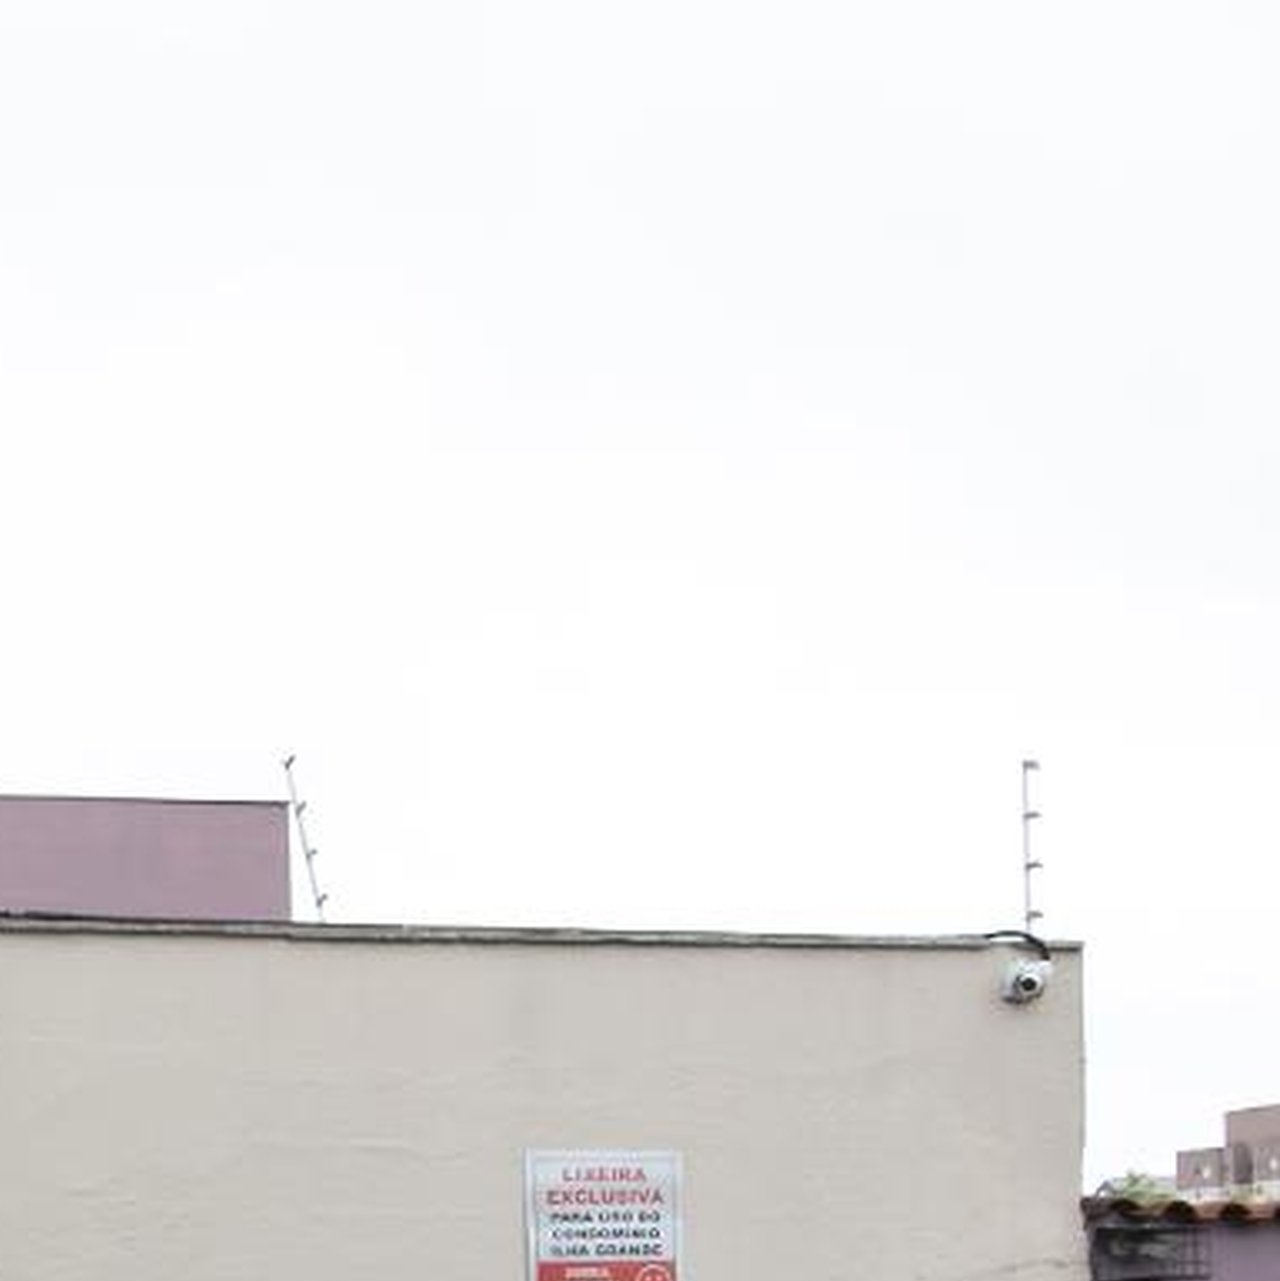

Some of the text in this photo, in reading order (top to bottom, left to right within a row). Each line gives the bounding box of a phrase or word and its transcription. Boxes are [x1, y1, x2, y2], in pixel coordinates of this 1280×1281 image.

[562, 1168, 646, 1182] LIXEIRA
[546, 1188, 664, 1205] EXCLUSIVA
[550, 1210, 661, 1223] PARA USO DO
